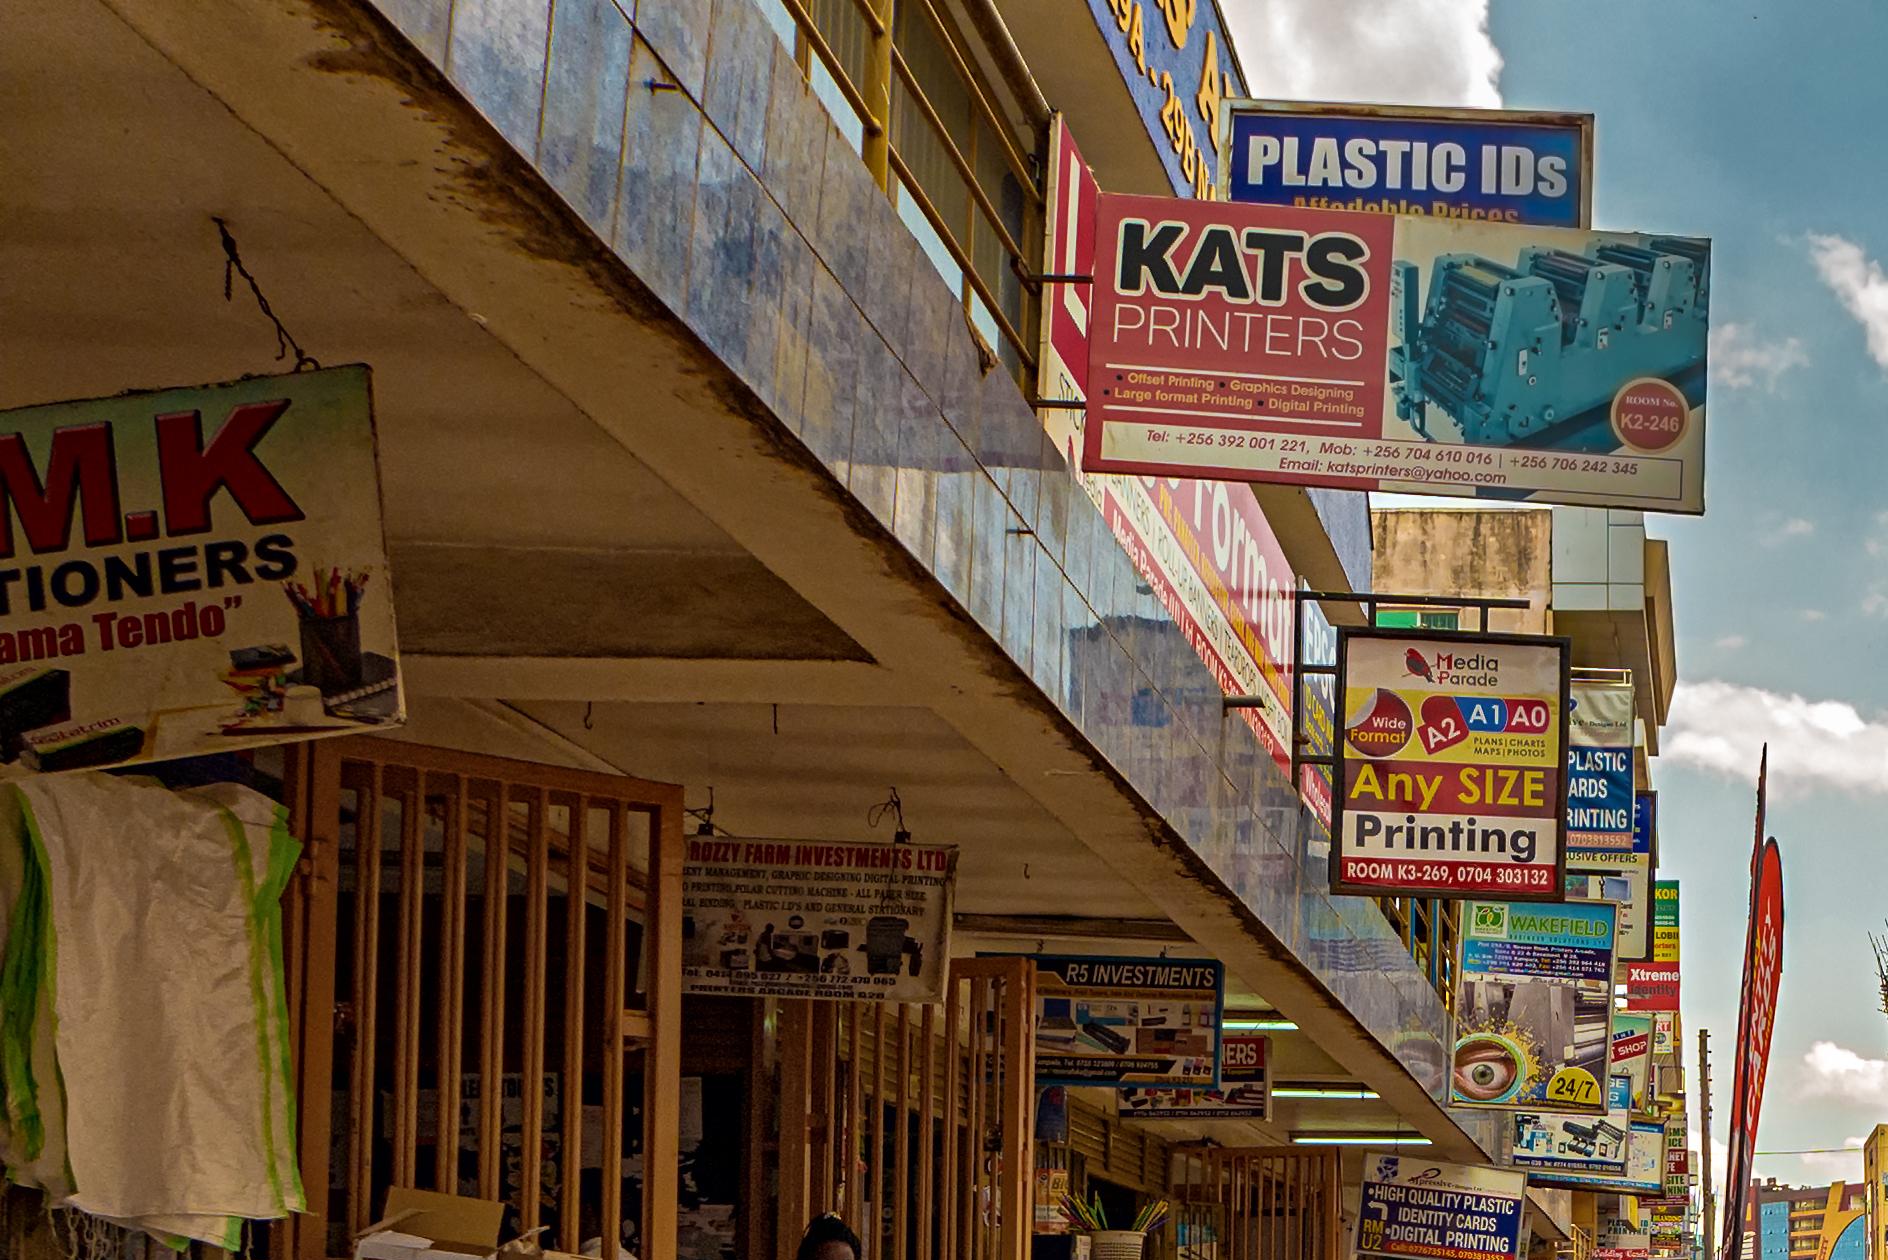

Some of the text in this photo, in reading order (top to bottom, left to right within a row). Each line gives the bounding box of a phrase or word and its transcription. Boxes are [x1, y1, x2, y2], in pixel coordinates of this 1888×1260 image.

[1247, 135, 1466, 194] PLASTIC
[1481, 145, 1567, 198] IDs
[1114, 217, 1371, 311] KATS
[1111, 303, 1364, 360] PRINTERS
[1127, 372, 1354, 400] Offset Printing Graphics Designing
[1114, 387, 1365, 417] Large format Printing Digital Printing
[1626, 396, 1660, 407] ROOM
[1620, 412, 1680, 433] K2-246
[1147, 429, 1169, 443] Tel:
[1176, 432, 1213, 445] +256
[1218, 435, 1244, 448] 392
[1249, 437, 1275, 449] 001
[1319, 441, 1356, 456] Mob:
[1362, 446, 1401, 459] +256
[1405, 448, 1431, 461] 704
[1435, 450, 1461, 463] 610
[1465, 451, 1493, 465] 016
[1510, 456, 1547, 470] +256
[1551, 457, 1578, 471] 706
[1581, 459, 1607, 473] 242
[1611, 461, 1638, 475] 345
[1279, 457, 1507, 484] Email: katsprinters@yahoo.com
[1436, 652, 1499, 673] Media
[1437, 670, 1499, 688] Parade
[1372, 716, 1407, 731] Wide
[1468, 704, 1547, 727] A1 A0
[1350, 728, 1407, 745] Format
[1425, 717, 1462, 750] A2
[1349, 763, 1546, 811] Any SIZE
[1355, 814, 1537, 863] Printing
[744, 843, 791, 865] FARM
[794, 845, 913, 870] INVESTMENTS
[916, 849, 948, 872] LTD
[1600, 854, 1639, 863] OFFERS
[864, 872, 900, 885] DIGITAL
[1346, 862, 1549, 886] ROOM K3-269, 0704 303132
[1510, 915, 1608, 937] WAKEFIELD
[1066, 963, 1215, 988] R5 INVESTMENTS
[1630, 968, 1680, 982] Xtreme
[1618, 1040, 1648, 1056] SHOP
[1554, 1077, 1595, 1101] 24/7
[1374, 1185, 1515, 1216] HIGH QUALITY PLASTIC
[1363, 1218, 1385, 1234] RM
[1398, 1206, 1497, 1232] IDENTITY CARDS
[1361, 1233, 1382, 1251] U2
[1389, 1224, 1510, 1253] DIGITAL PRINTING
